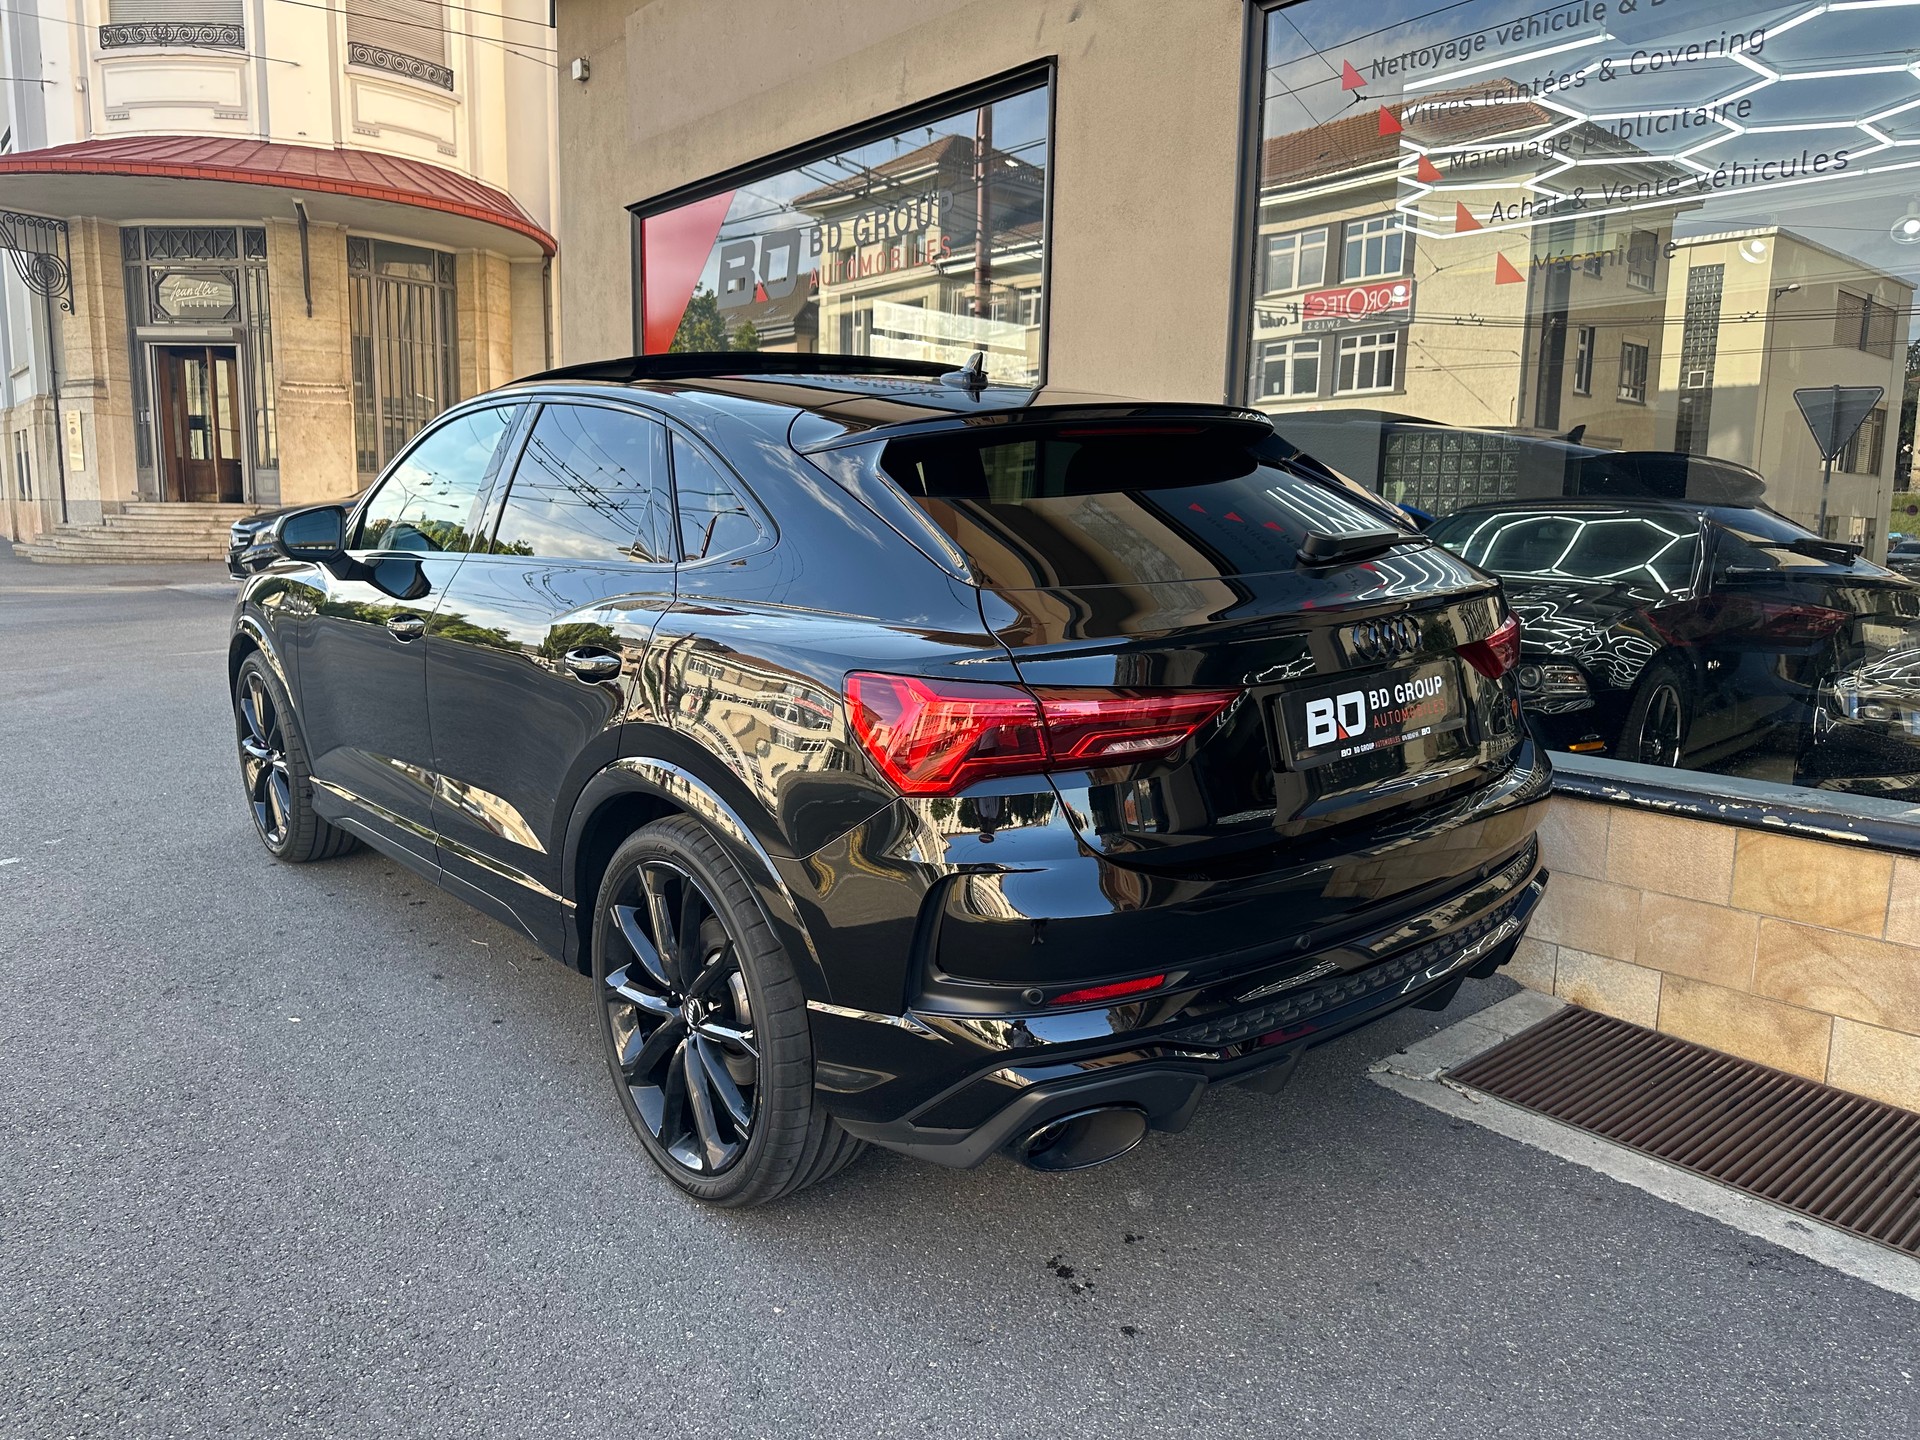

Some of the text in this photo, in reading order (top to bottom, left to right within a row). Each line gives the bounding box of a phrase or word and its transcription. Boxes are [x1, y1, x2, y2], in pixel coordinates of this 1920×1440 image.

[1371, 34, 1487, 80] Nettoyage
[1496, 1, 1607, 46] véhicule
[1405, 27, 1767, 126] Vitres teintées & Covering
[1449, 98, 1752, 171] Marquage publicitaire
[1488, 149, 1850, 224] Achat & Vente véhicules
[809, 190, 954, 258] BD GROUP
[808, 235, 953, 290] AUTOMOBILES
[1532, 240, 1677, 272] Mécanique
[1305, 690, 1367, 748] BD
[1368, 675, 1443, 710] BD GROUP
[1373, 697, 1445, 728] AUTOMOBILES
